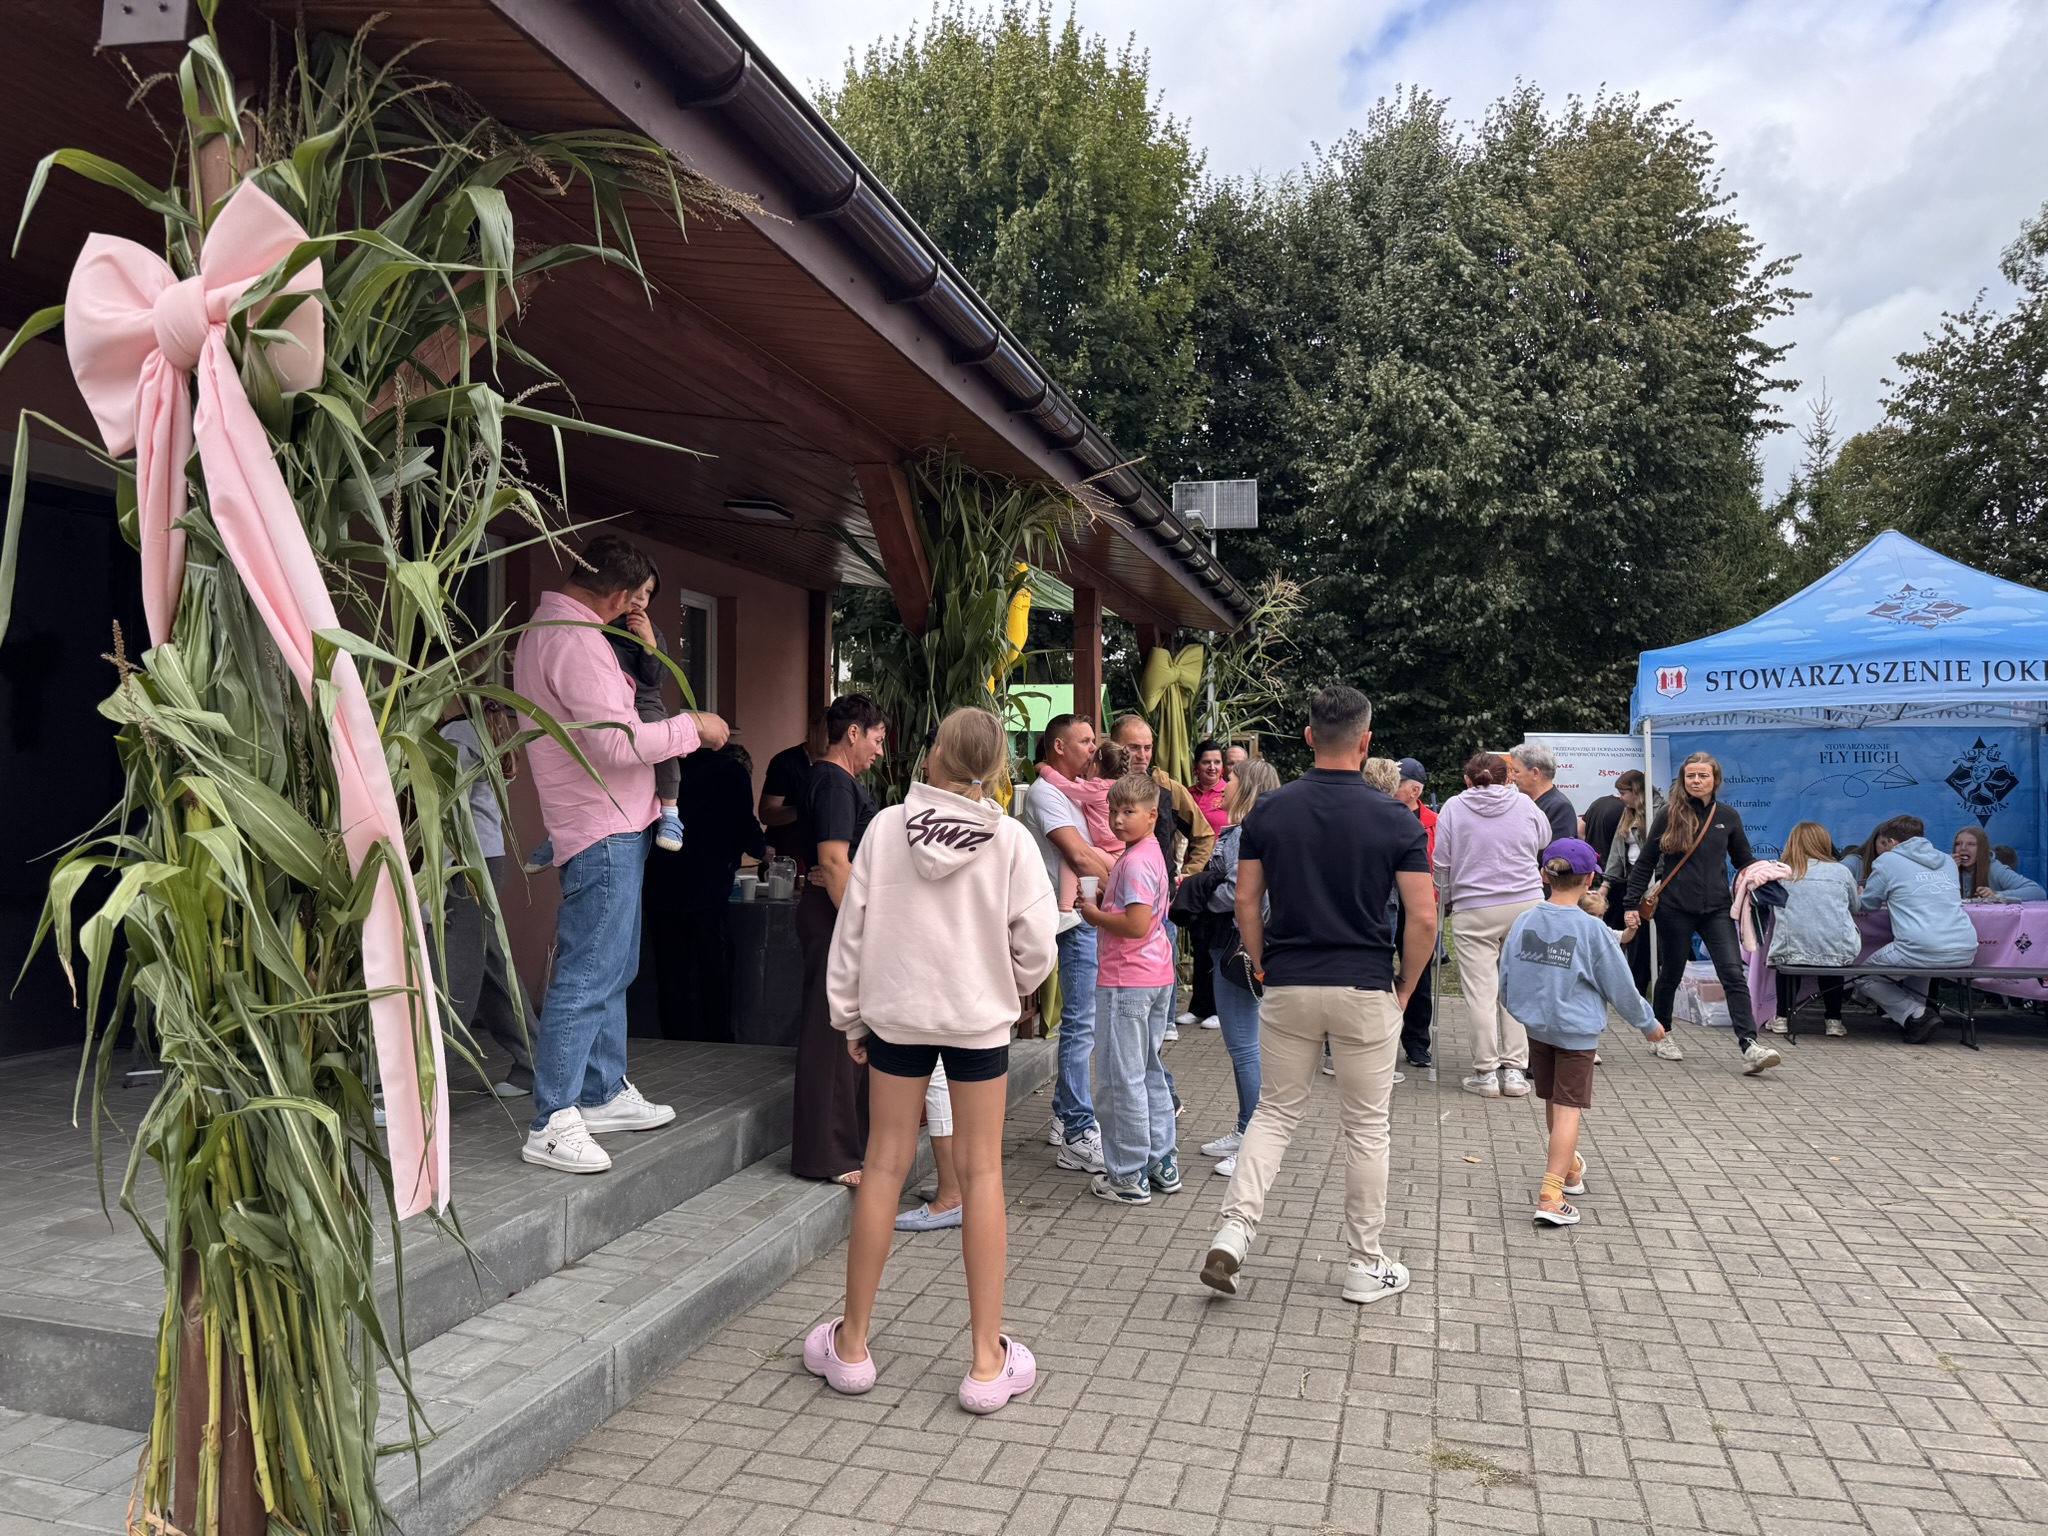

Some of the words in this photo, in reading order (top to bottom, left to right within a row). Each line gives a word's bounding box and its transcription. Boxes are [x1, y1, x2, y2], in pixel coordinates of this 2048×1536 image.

[1706, 659, 1971, 692] STOWARZYSZENIE
[1819, 751, 1849, 764] FLY
[1854, 751, 1899, 764] HIGH
[1962, 748, 2002, 758] JOKER
[1723, 774, 1775, 785] edukacyjne
[1560, 948, 1571, 957] The
